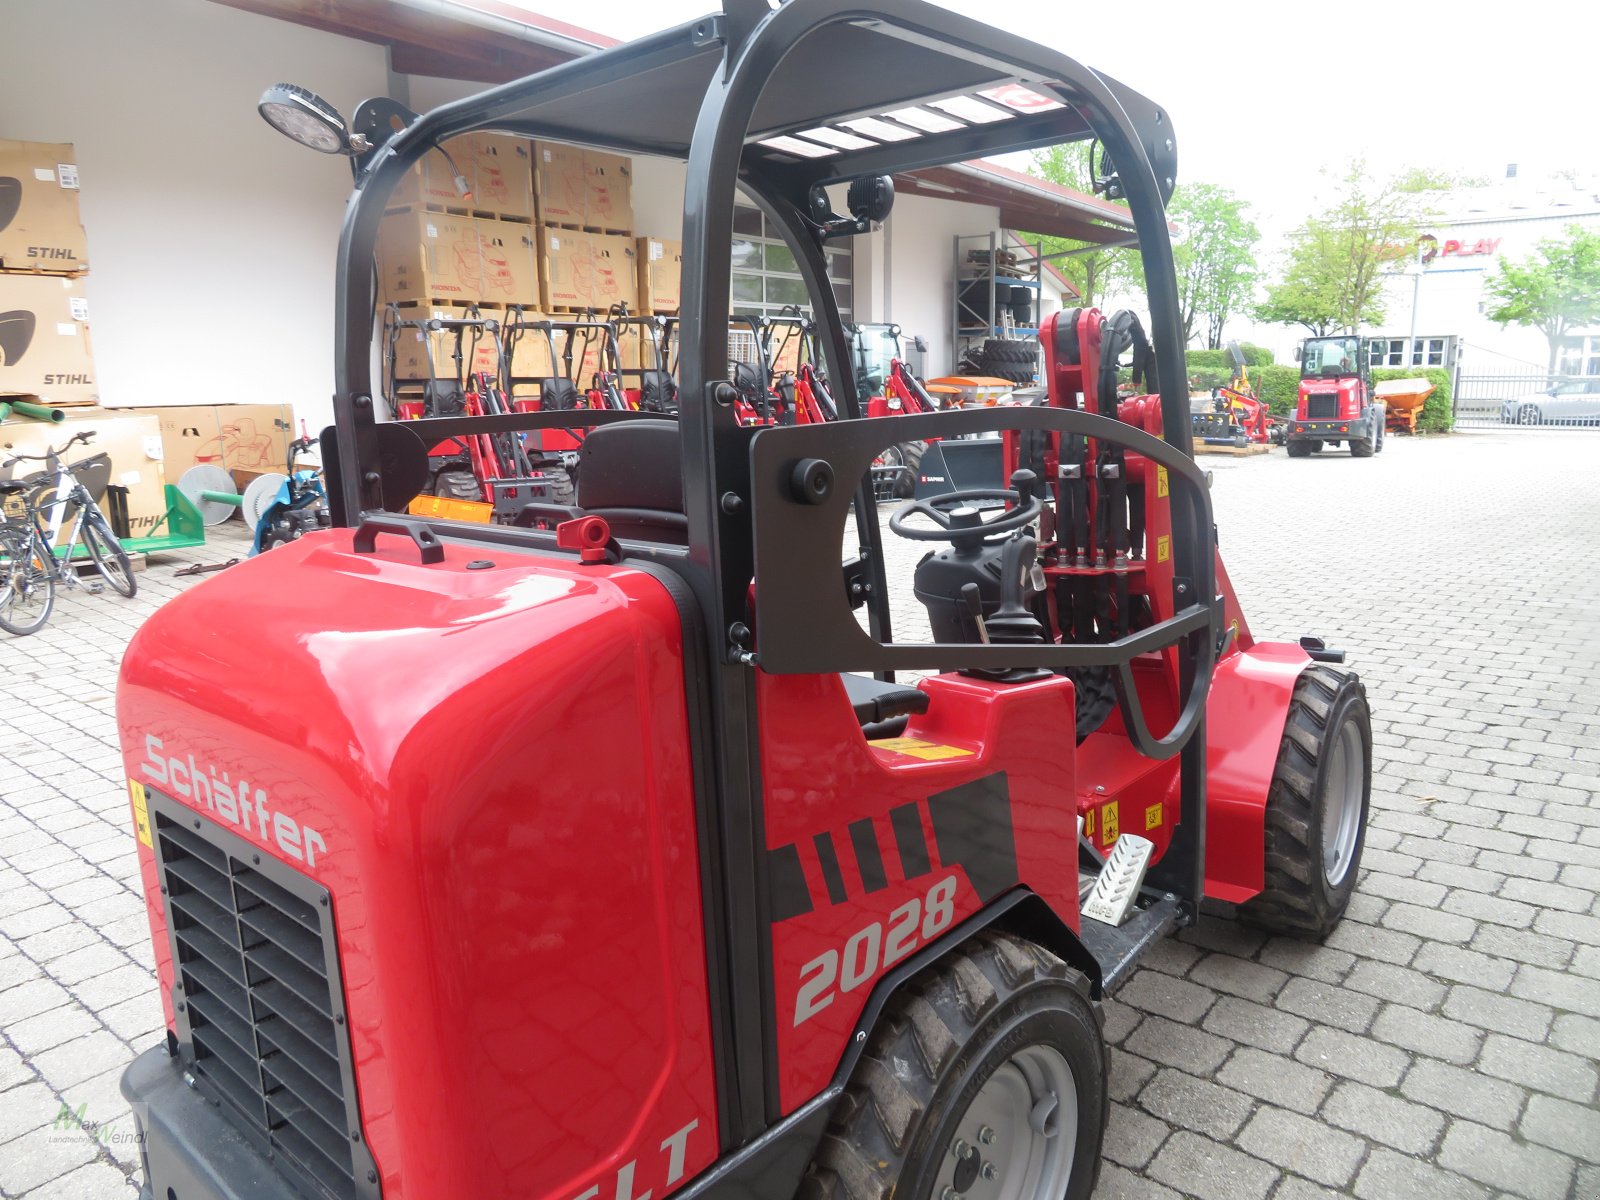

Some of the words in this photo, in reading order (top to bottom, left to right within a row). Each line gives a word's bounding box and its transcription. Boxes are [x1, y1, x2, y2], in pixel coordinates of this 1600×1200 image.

[27, 246, 77, 260] STIHL
[1442, 238, 1503, 257] PLAY
[43, 374, 93, 385] STIHL
[128, 515, 164, 529] TIHL
[141, 734, 327, 868] Schäffer
[793, 875, 957, 1028] 2028
